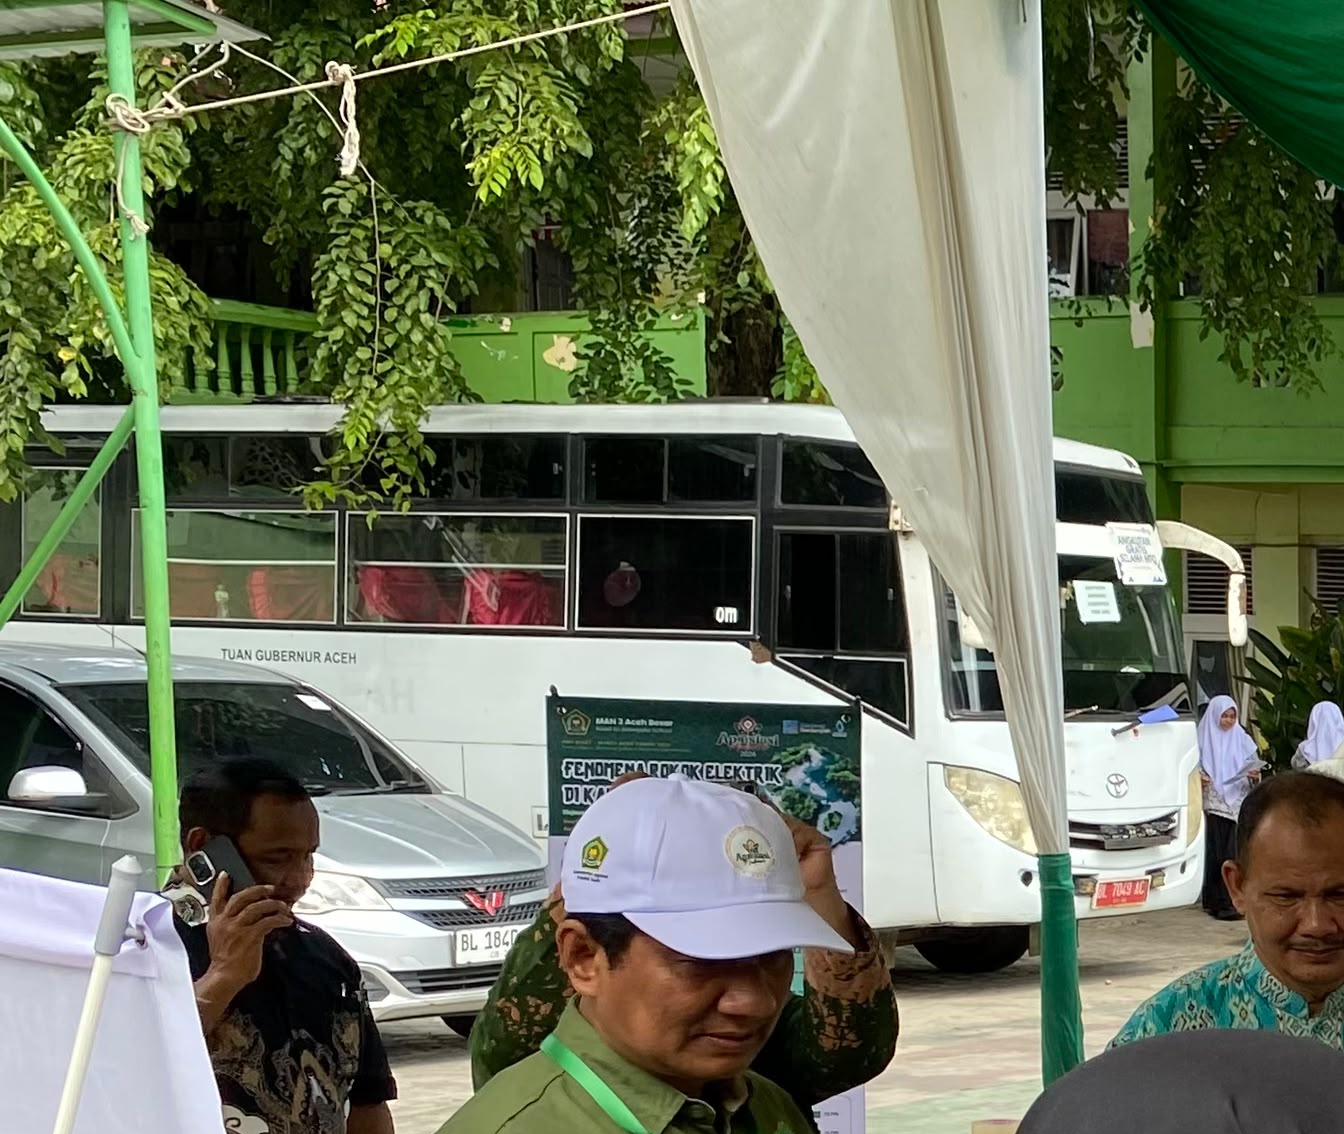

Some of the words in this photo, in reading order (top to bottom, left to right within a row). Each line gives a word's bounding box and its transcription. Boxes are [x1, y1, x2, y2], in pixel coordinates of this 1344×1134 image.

[221, 648, 251, 661] TUAN
[255, 649, 321, 663] GUBERNUR
[324, 651, 357, 664] ACEH
[595, 717, 616, 725] MAN
[624, 718, 647, 726] Aceh
[562, 759, 647, 781] FENOMENA
[703, 763, 783, 784] ELEKTRIK
[561, 785, 580, 804] DI
[461, 934, 478, 952] BL
